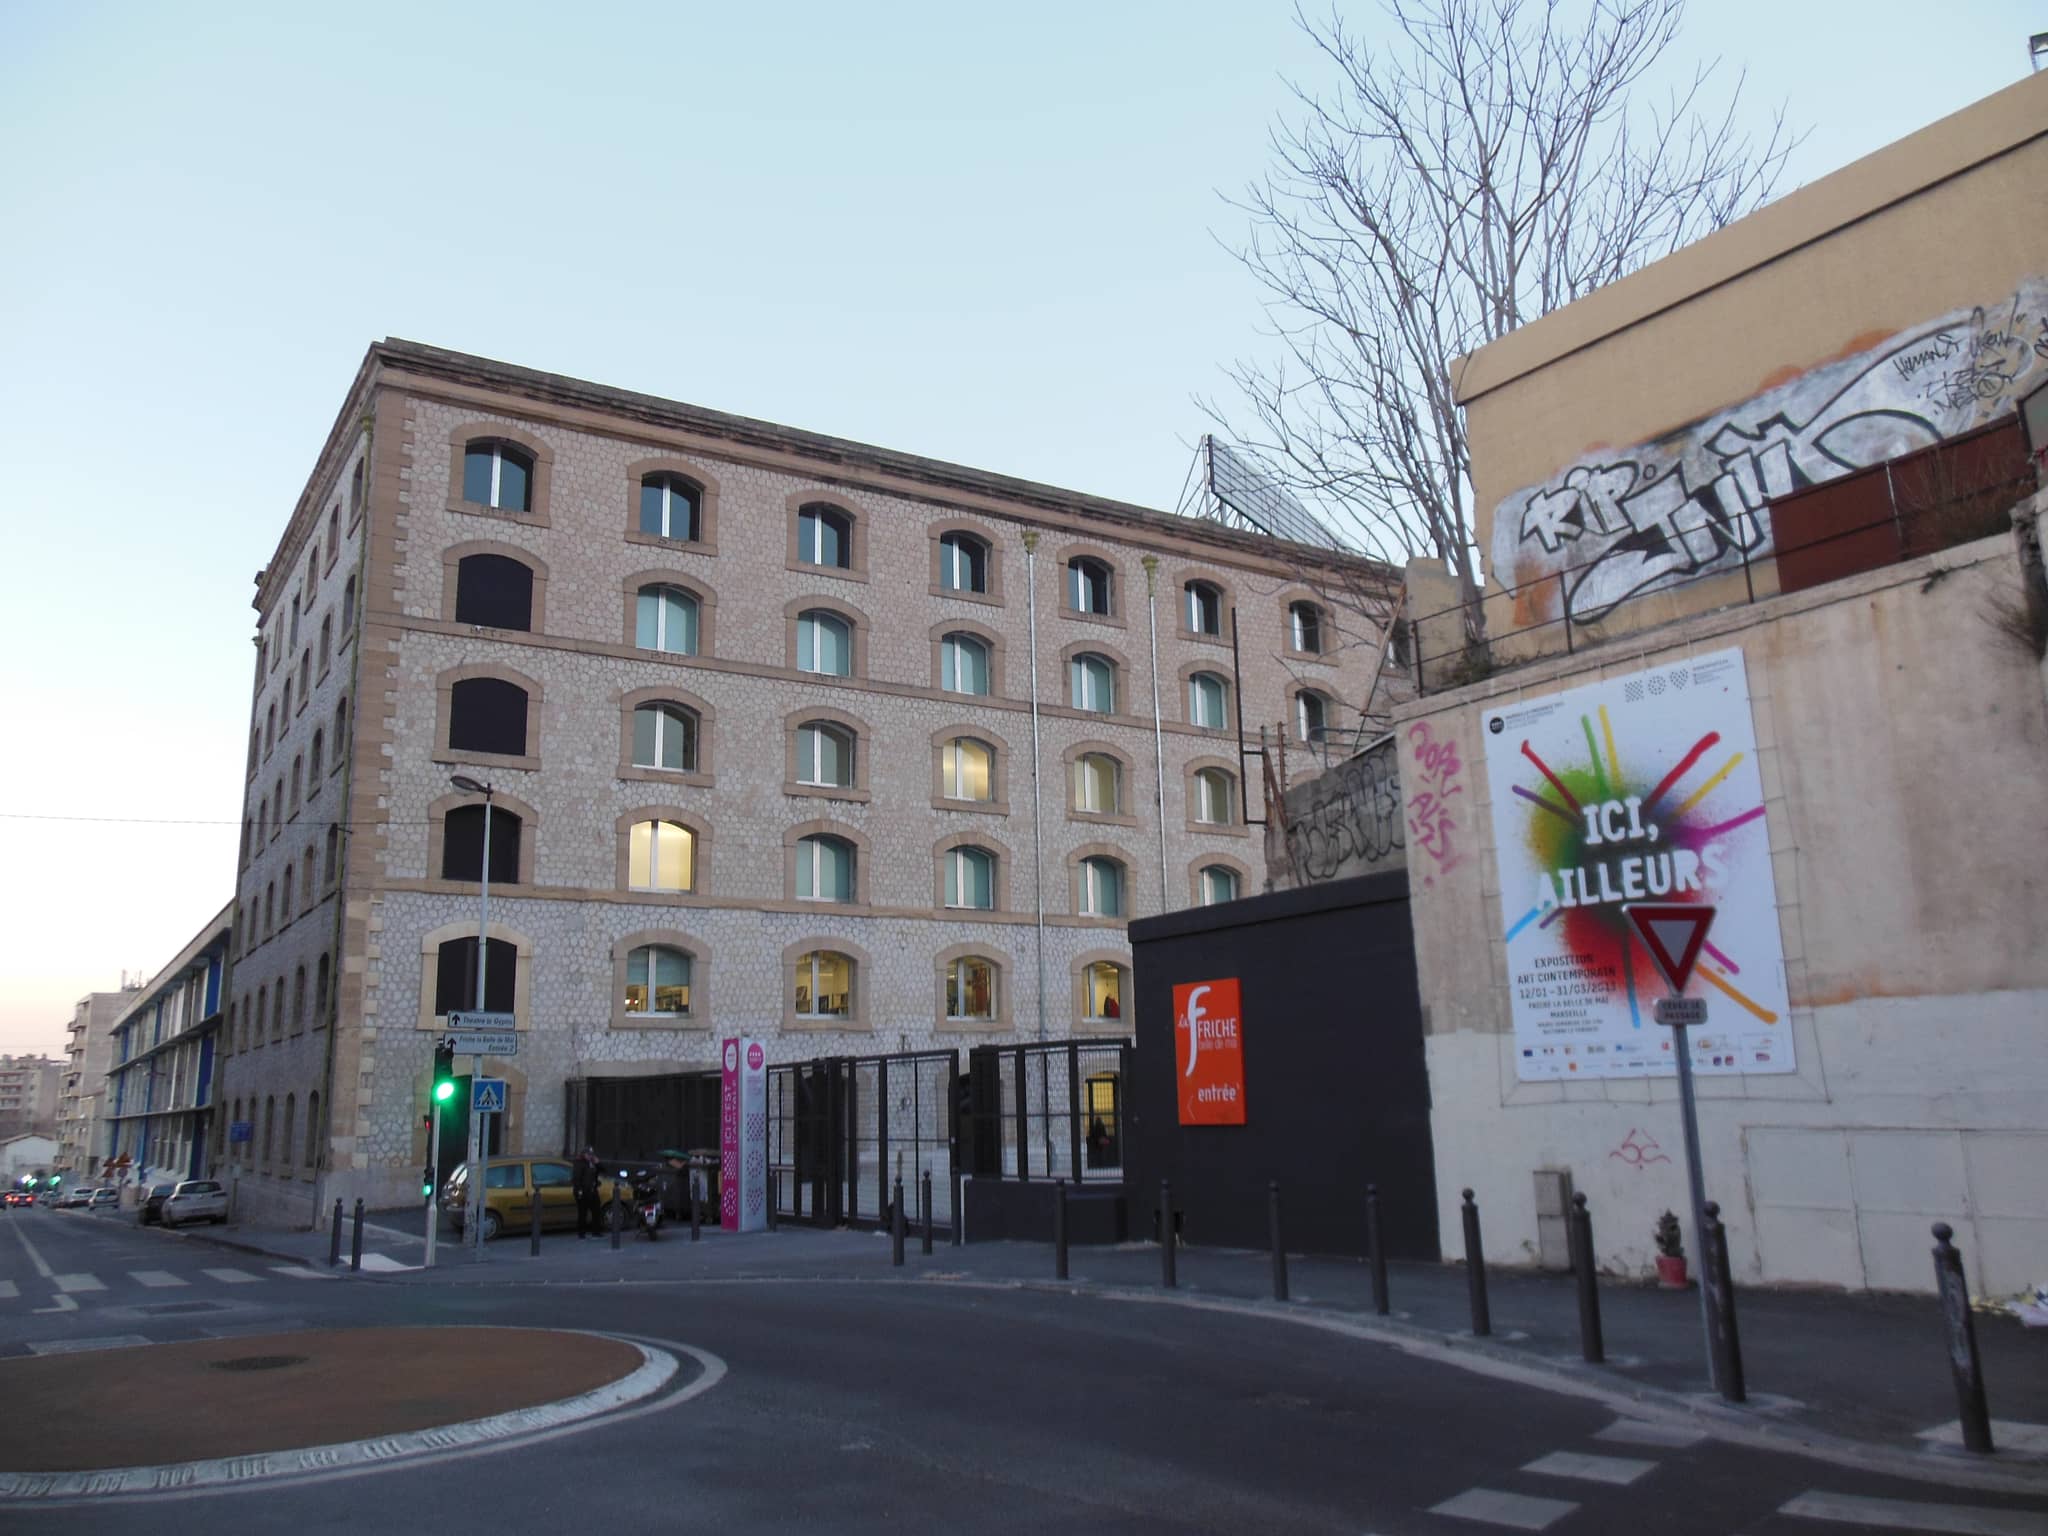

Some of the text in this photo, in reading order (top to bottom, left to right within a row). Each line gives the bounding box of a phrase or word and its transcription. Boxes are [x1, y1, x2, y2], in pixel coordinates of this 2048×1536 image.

[1582, 796, 1659, 845] ICI,
[1537, 843, 1729, 911] AILLEURS
[1534, 954, 1595, 969] EXPOSITION
[1518, 965, 1616, 985] ART CONTEMPORAIN
[1550, 1009, 1587, 1018] MARSEILLE
[1197, 1018, 1238, 1040] FRICHE
[1198, 1083, 1236, 1102] entrée
